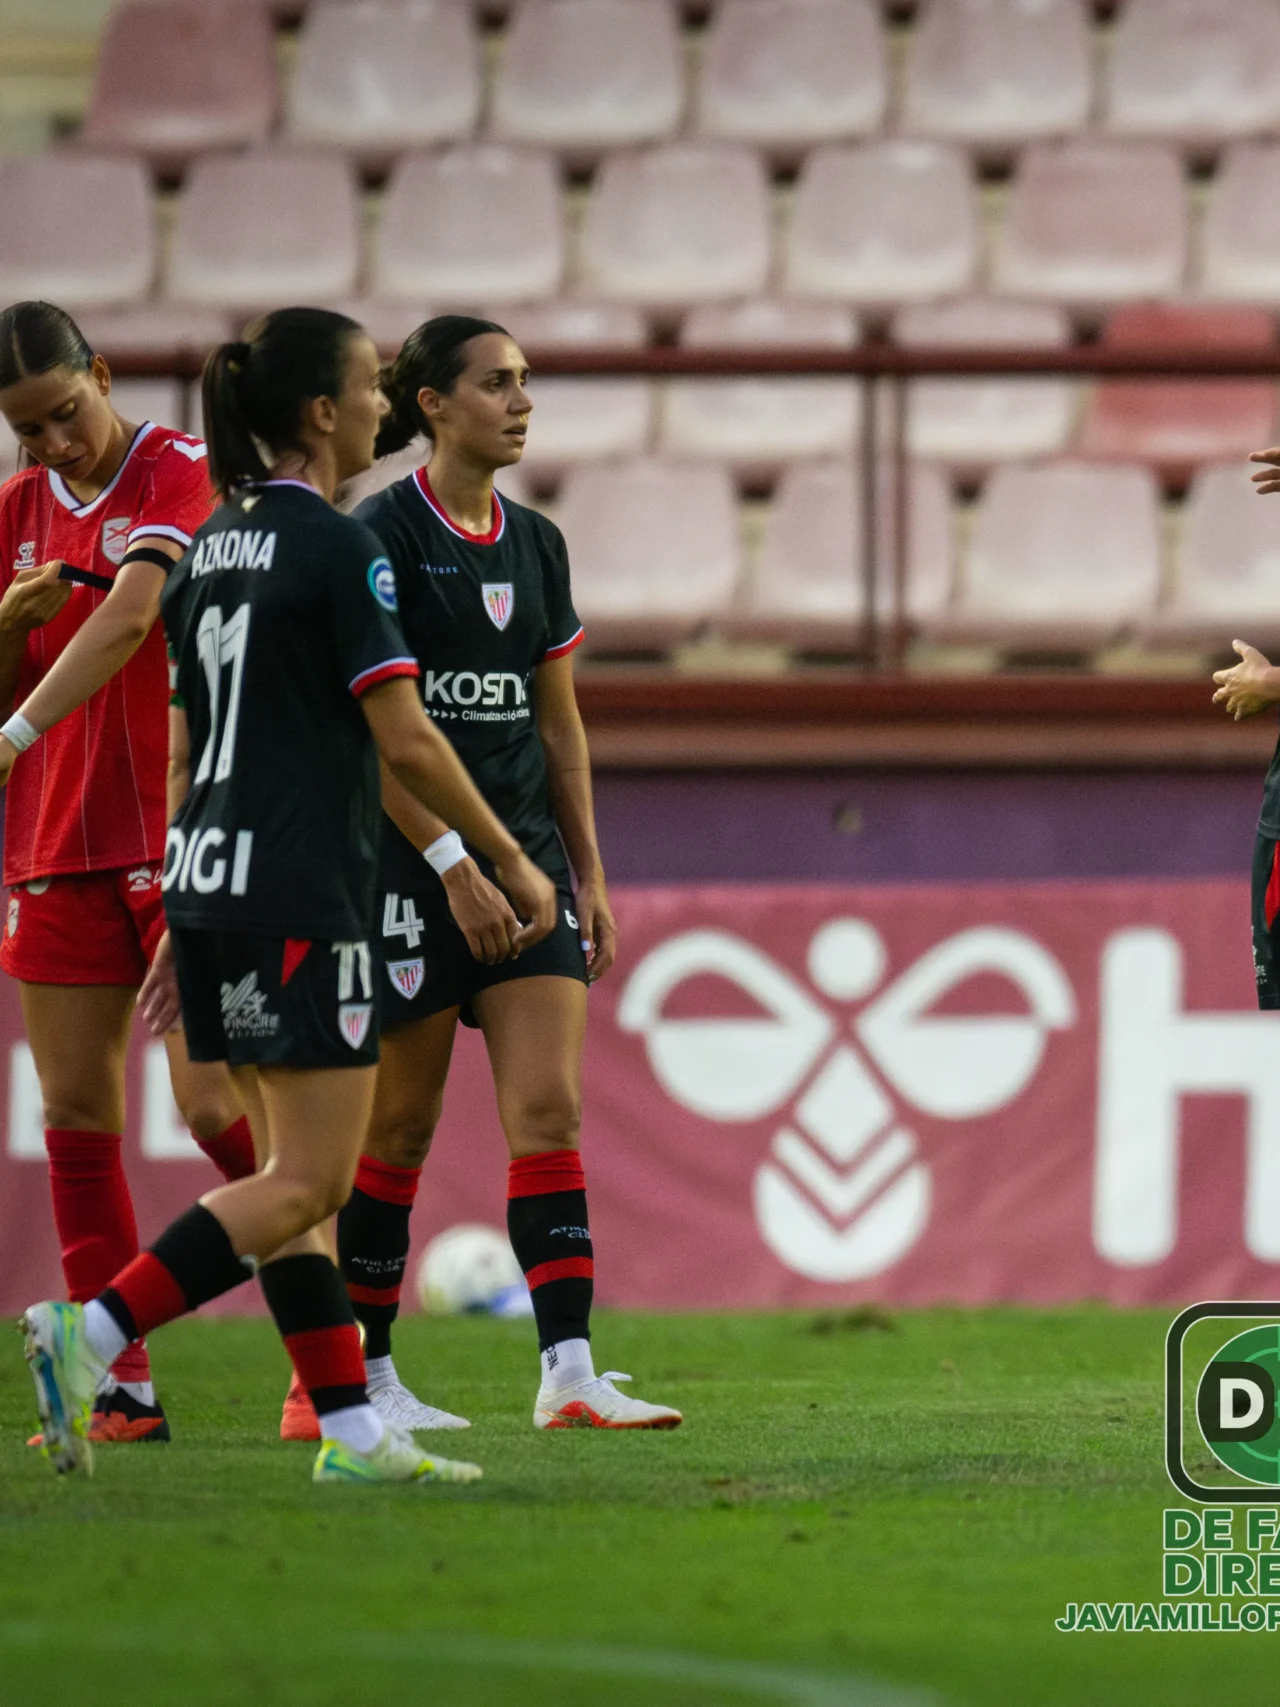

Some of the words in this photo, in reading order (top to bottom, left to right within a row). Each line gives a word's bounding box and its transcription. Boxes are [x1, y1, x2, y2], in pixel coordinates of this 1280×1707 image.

[191, 529, 277, 579] AZKONA
[195, 602, 250, 785] 11
[161, 826, 254, 896] DIGI
[382, 892, 425, 950] 4
[331, 940, 374, 1001] 11
